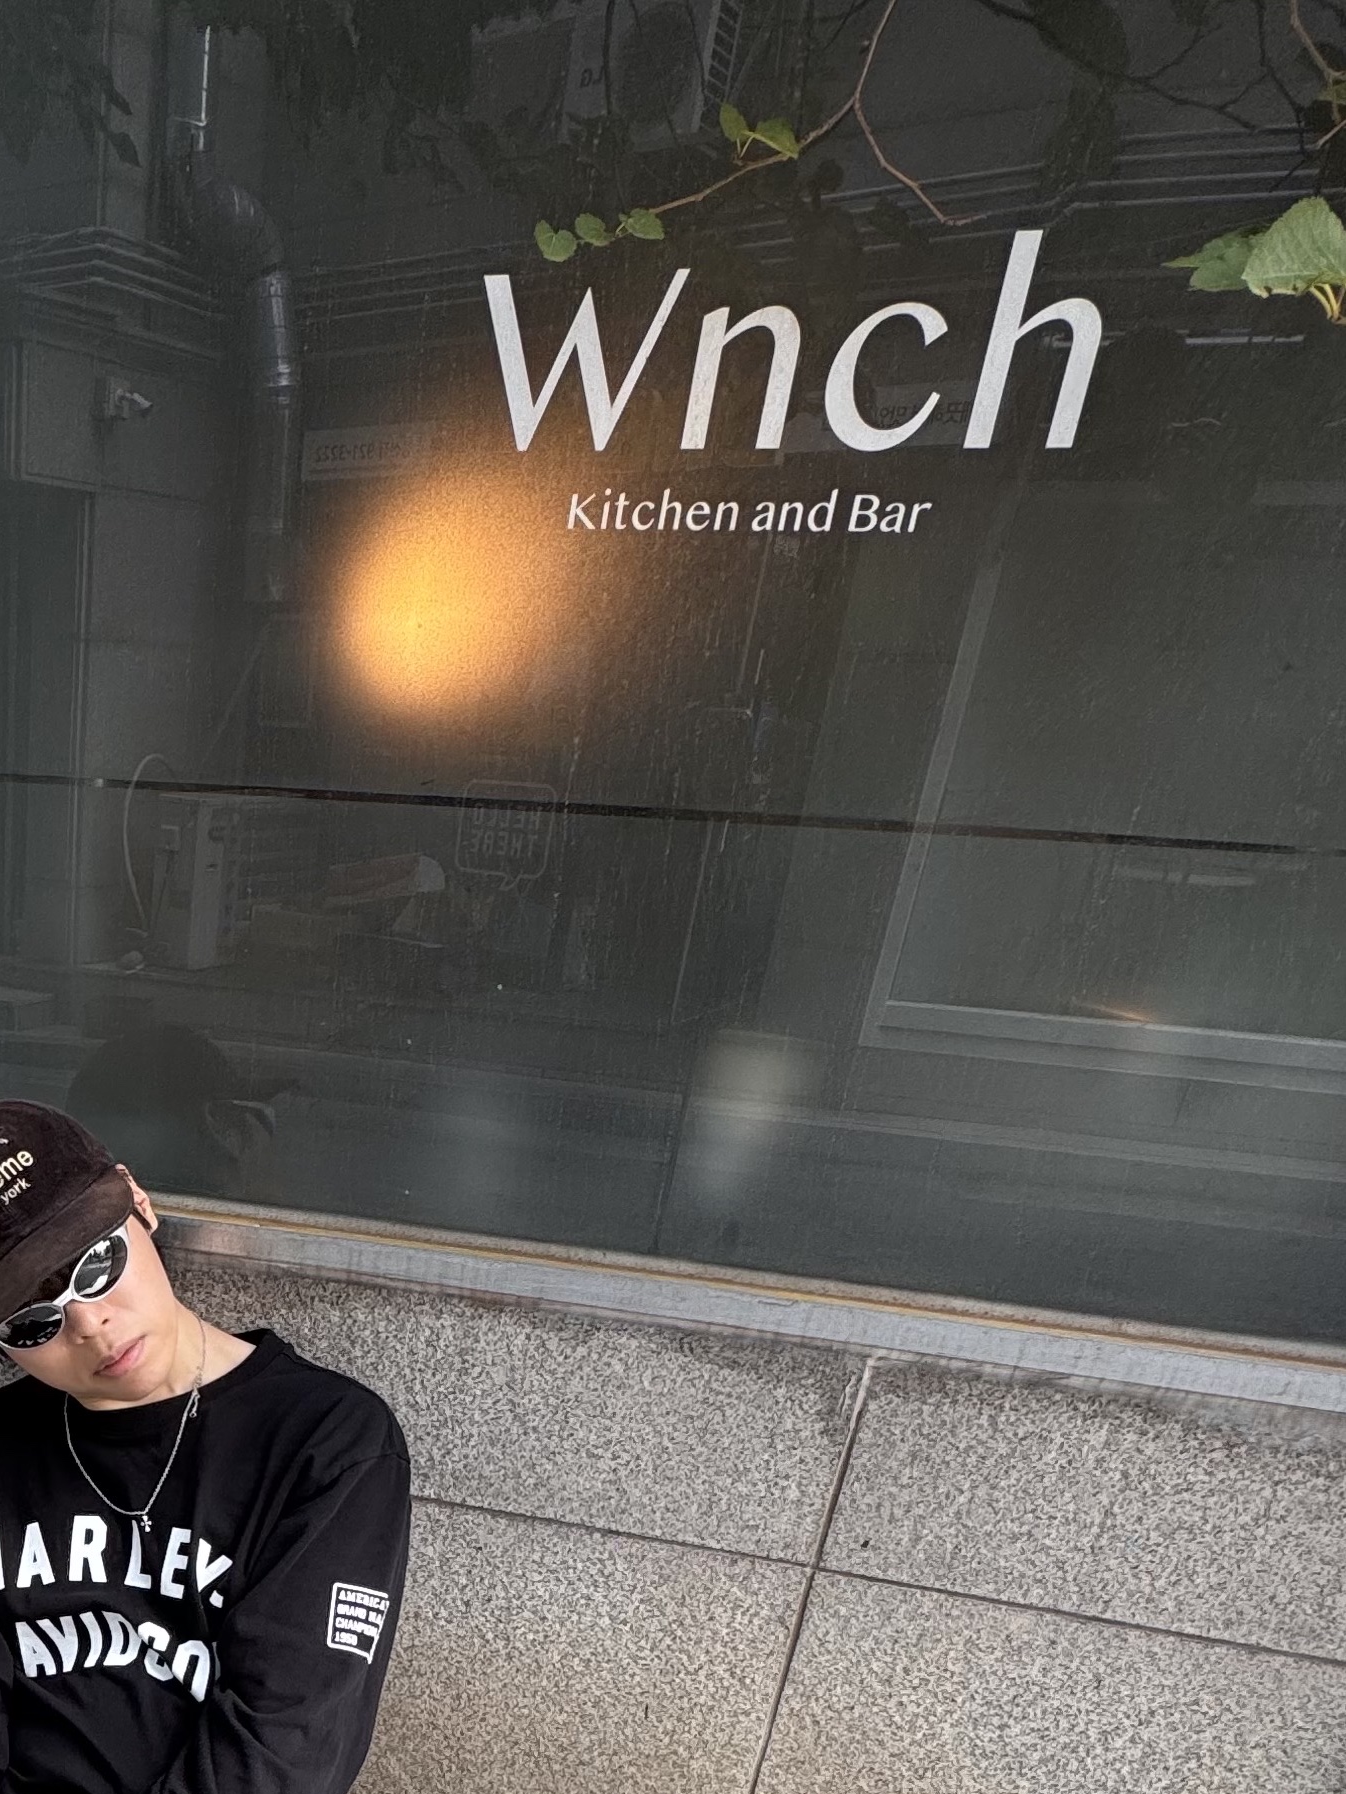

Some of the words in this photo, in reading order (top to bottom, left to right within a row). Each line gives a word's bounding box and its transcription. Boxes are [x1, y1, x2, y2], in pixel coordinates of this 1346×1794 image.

[484, 230, 1102, 451] Wnch
[566, 488, 740, 531] Kitchen
[751, 489, 839, 533] and
[847, 494, 933, 533] Bar
[0, 1178, 31, 1205] york
